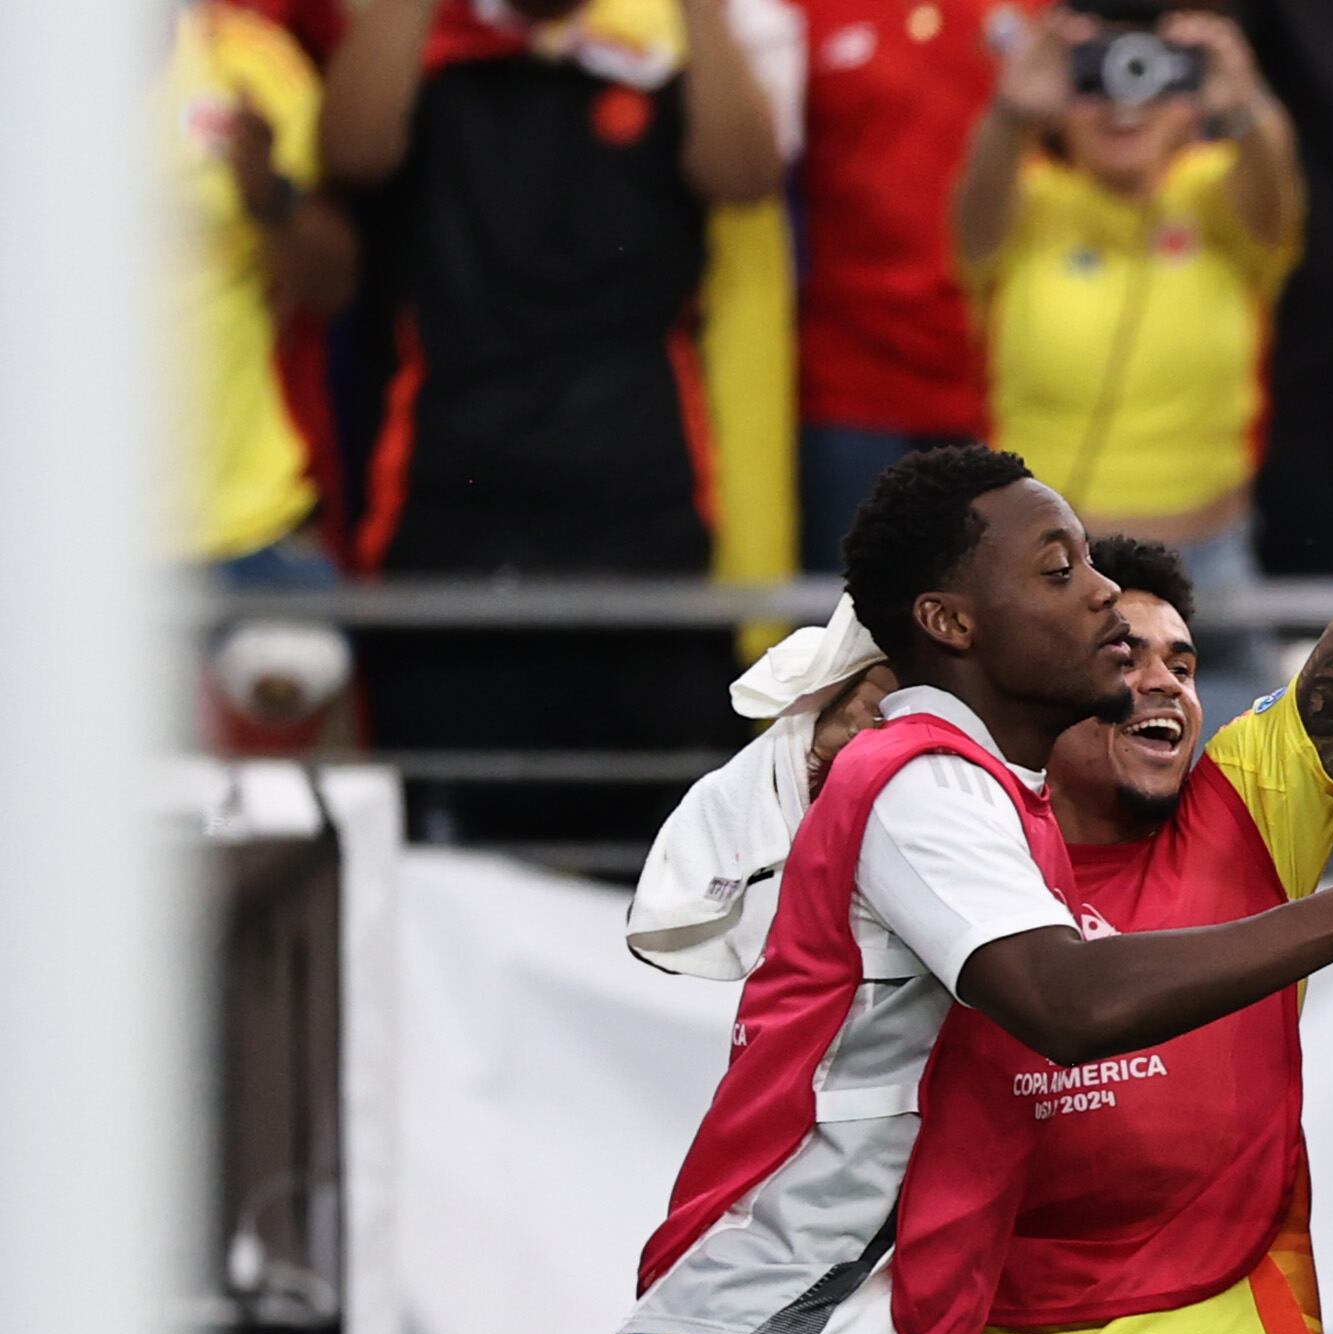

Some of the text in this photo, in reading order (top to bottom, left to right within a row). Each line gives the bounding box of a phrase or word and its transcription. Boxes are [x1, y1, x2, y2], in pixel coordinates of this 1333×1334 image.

[1013, 1054, 1168, 1096] COPA AMERICA
[1060, 1090, 1116, 1114] 2024
